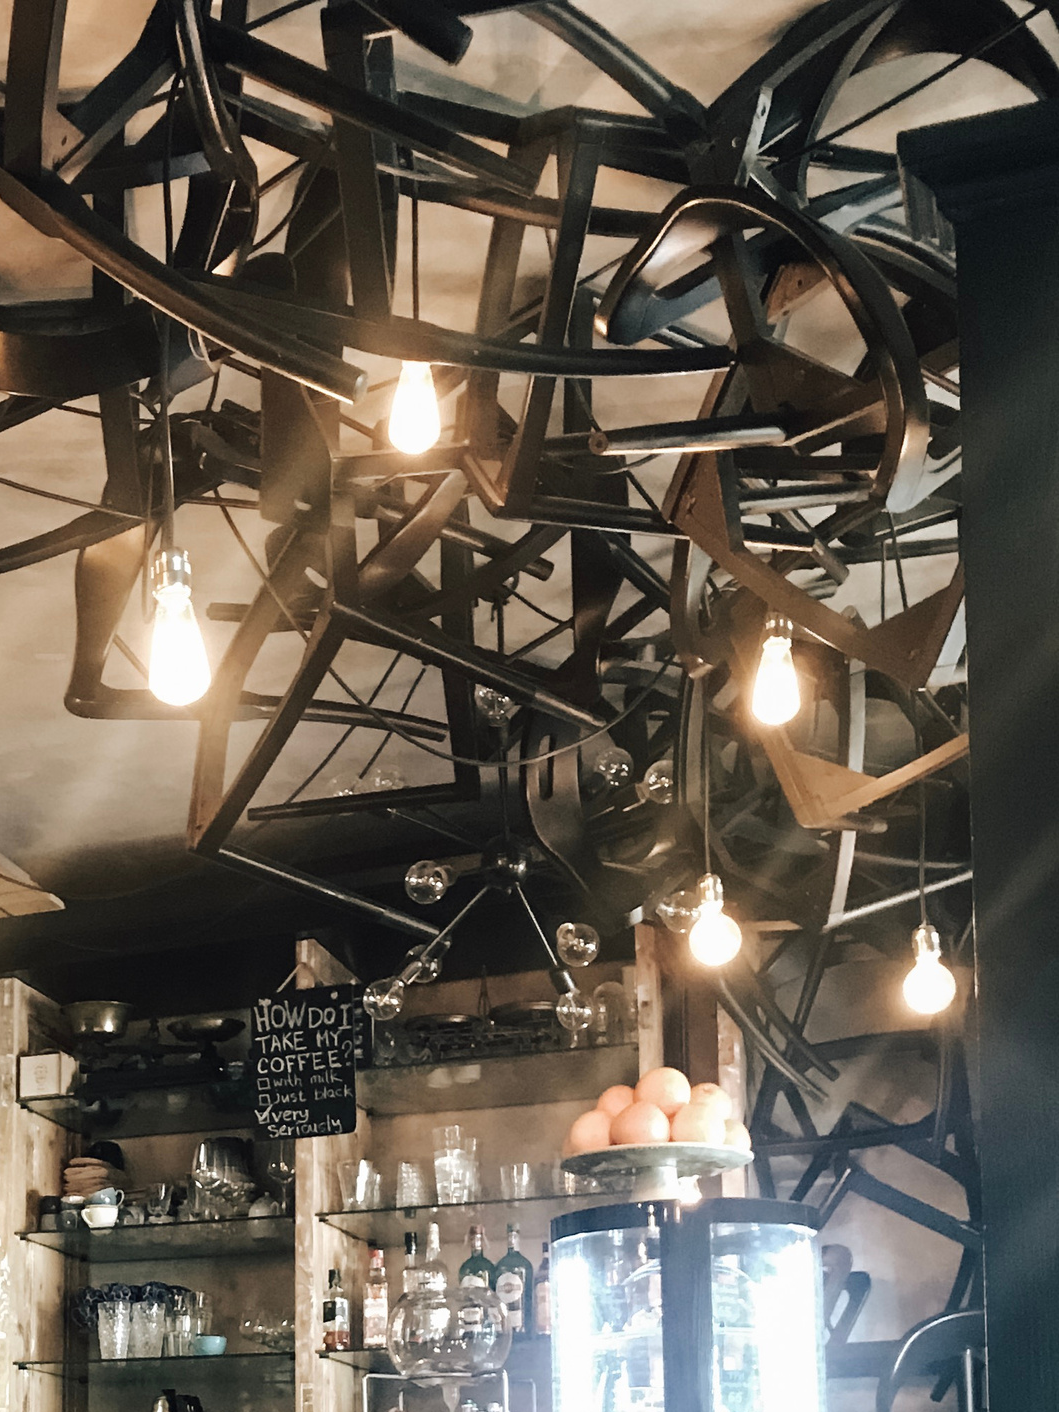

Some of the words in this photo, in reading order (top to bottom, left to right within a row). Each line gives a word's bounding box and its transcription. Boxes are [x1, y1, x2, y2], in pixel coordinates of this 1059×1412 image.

[254, 1000, 306, 1032] HOW
[308, 1007, 336, 1028] DO
[339, 1004, 352, 1030] I
[255, 1031, 307, 1054] TAKE
[316, 1030, 342, 1047] MY
[273, 1073, 302, 1088] with
[310, 1070, 343, 1084] milk
[314, 1085, 353, 1100] black
[271, 1108, 309, 1122] very
